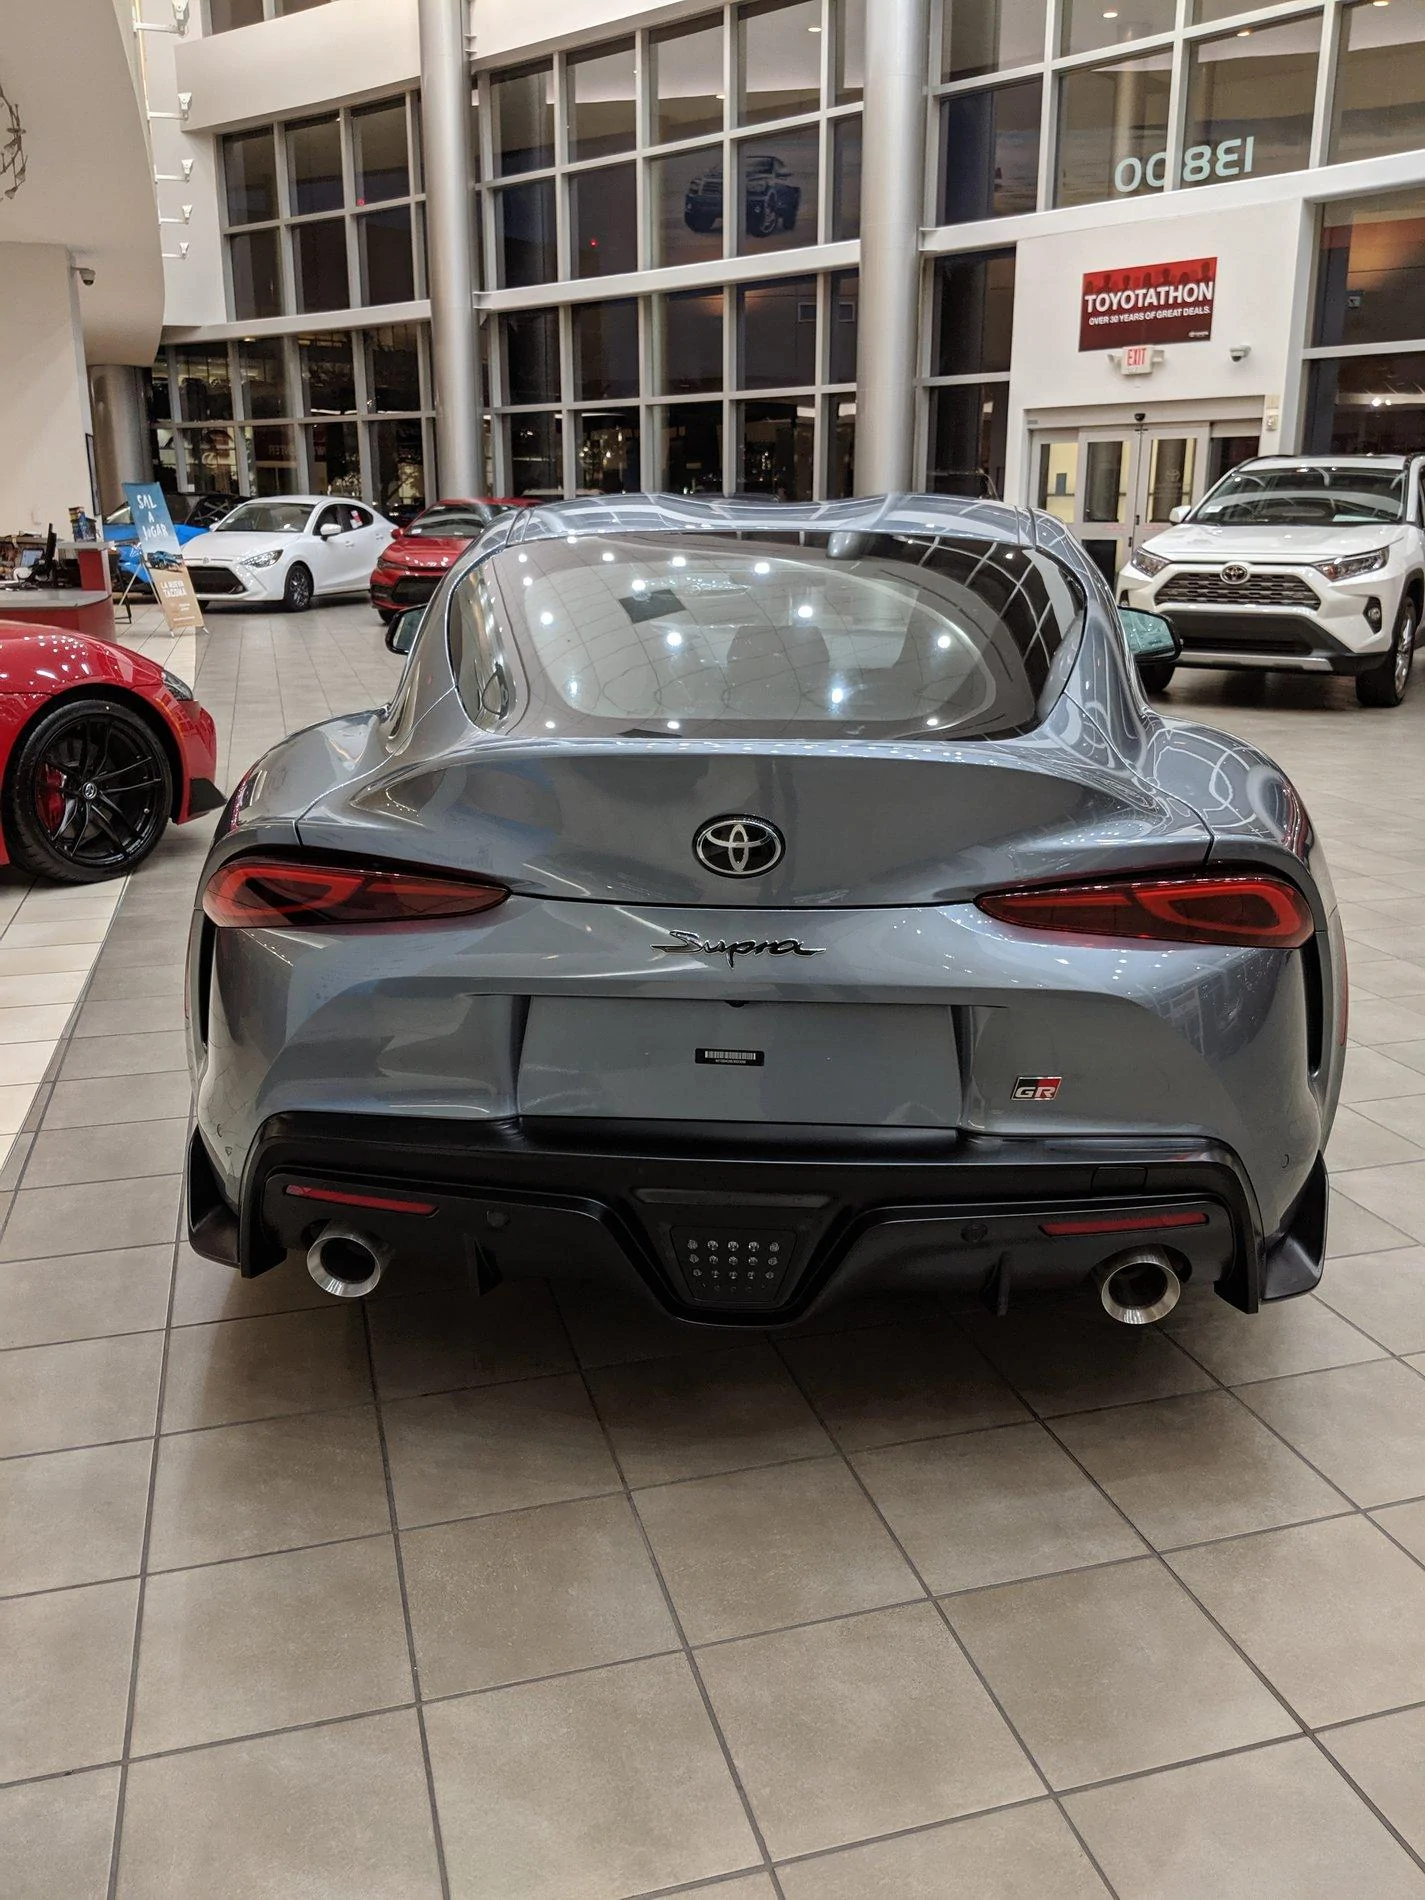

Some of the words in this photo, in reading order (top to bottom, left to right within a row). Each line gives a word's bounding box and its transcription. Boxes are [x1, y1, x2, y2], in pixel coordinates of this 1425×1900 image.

[1084, 281, 1213, 313] TOYOTATHON
[1088, 315, 1110, 326] OVER
[1119, 312, 1145, 323] YEARS
[1145, 311, 1156, 320] OF
[1156, 308, 1183, 318] GREAT
[1127, 348, 1146, 366] EXIT
[136, 494, 158, 509] SAL
[147, 511, 155, 523] A
[650, 929, 827, 970] Supra
[1014, 1086, 1056, 1098] GR
